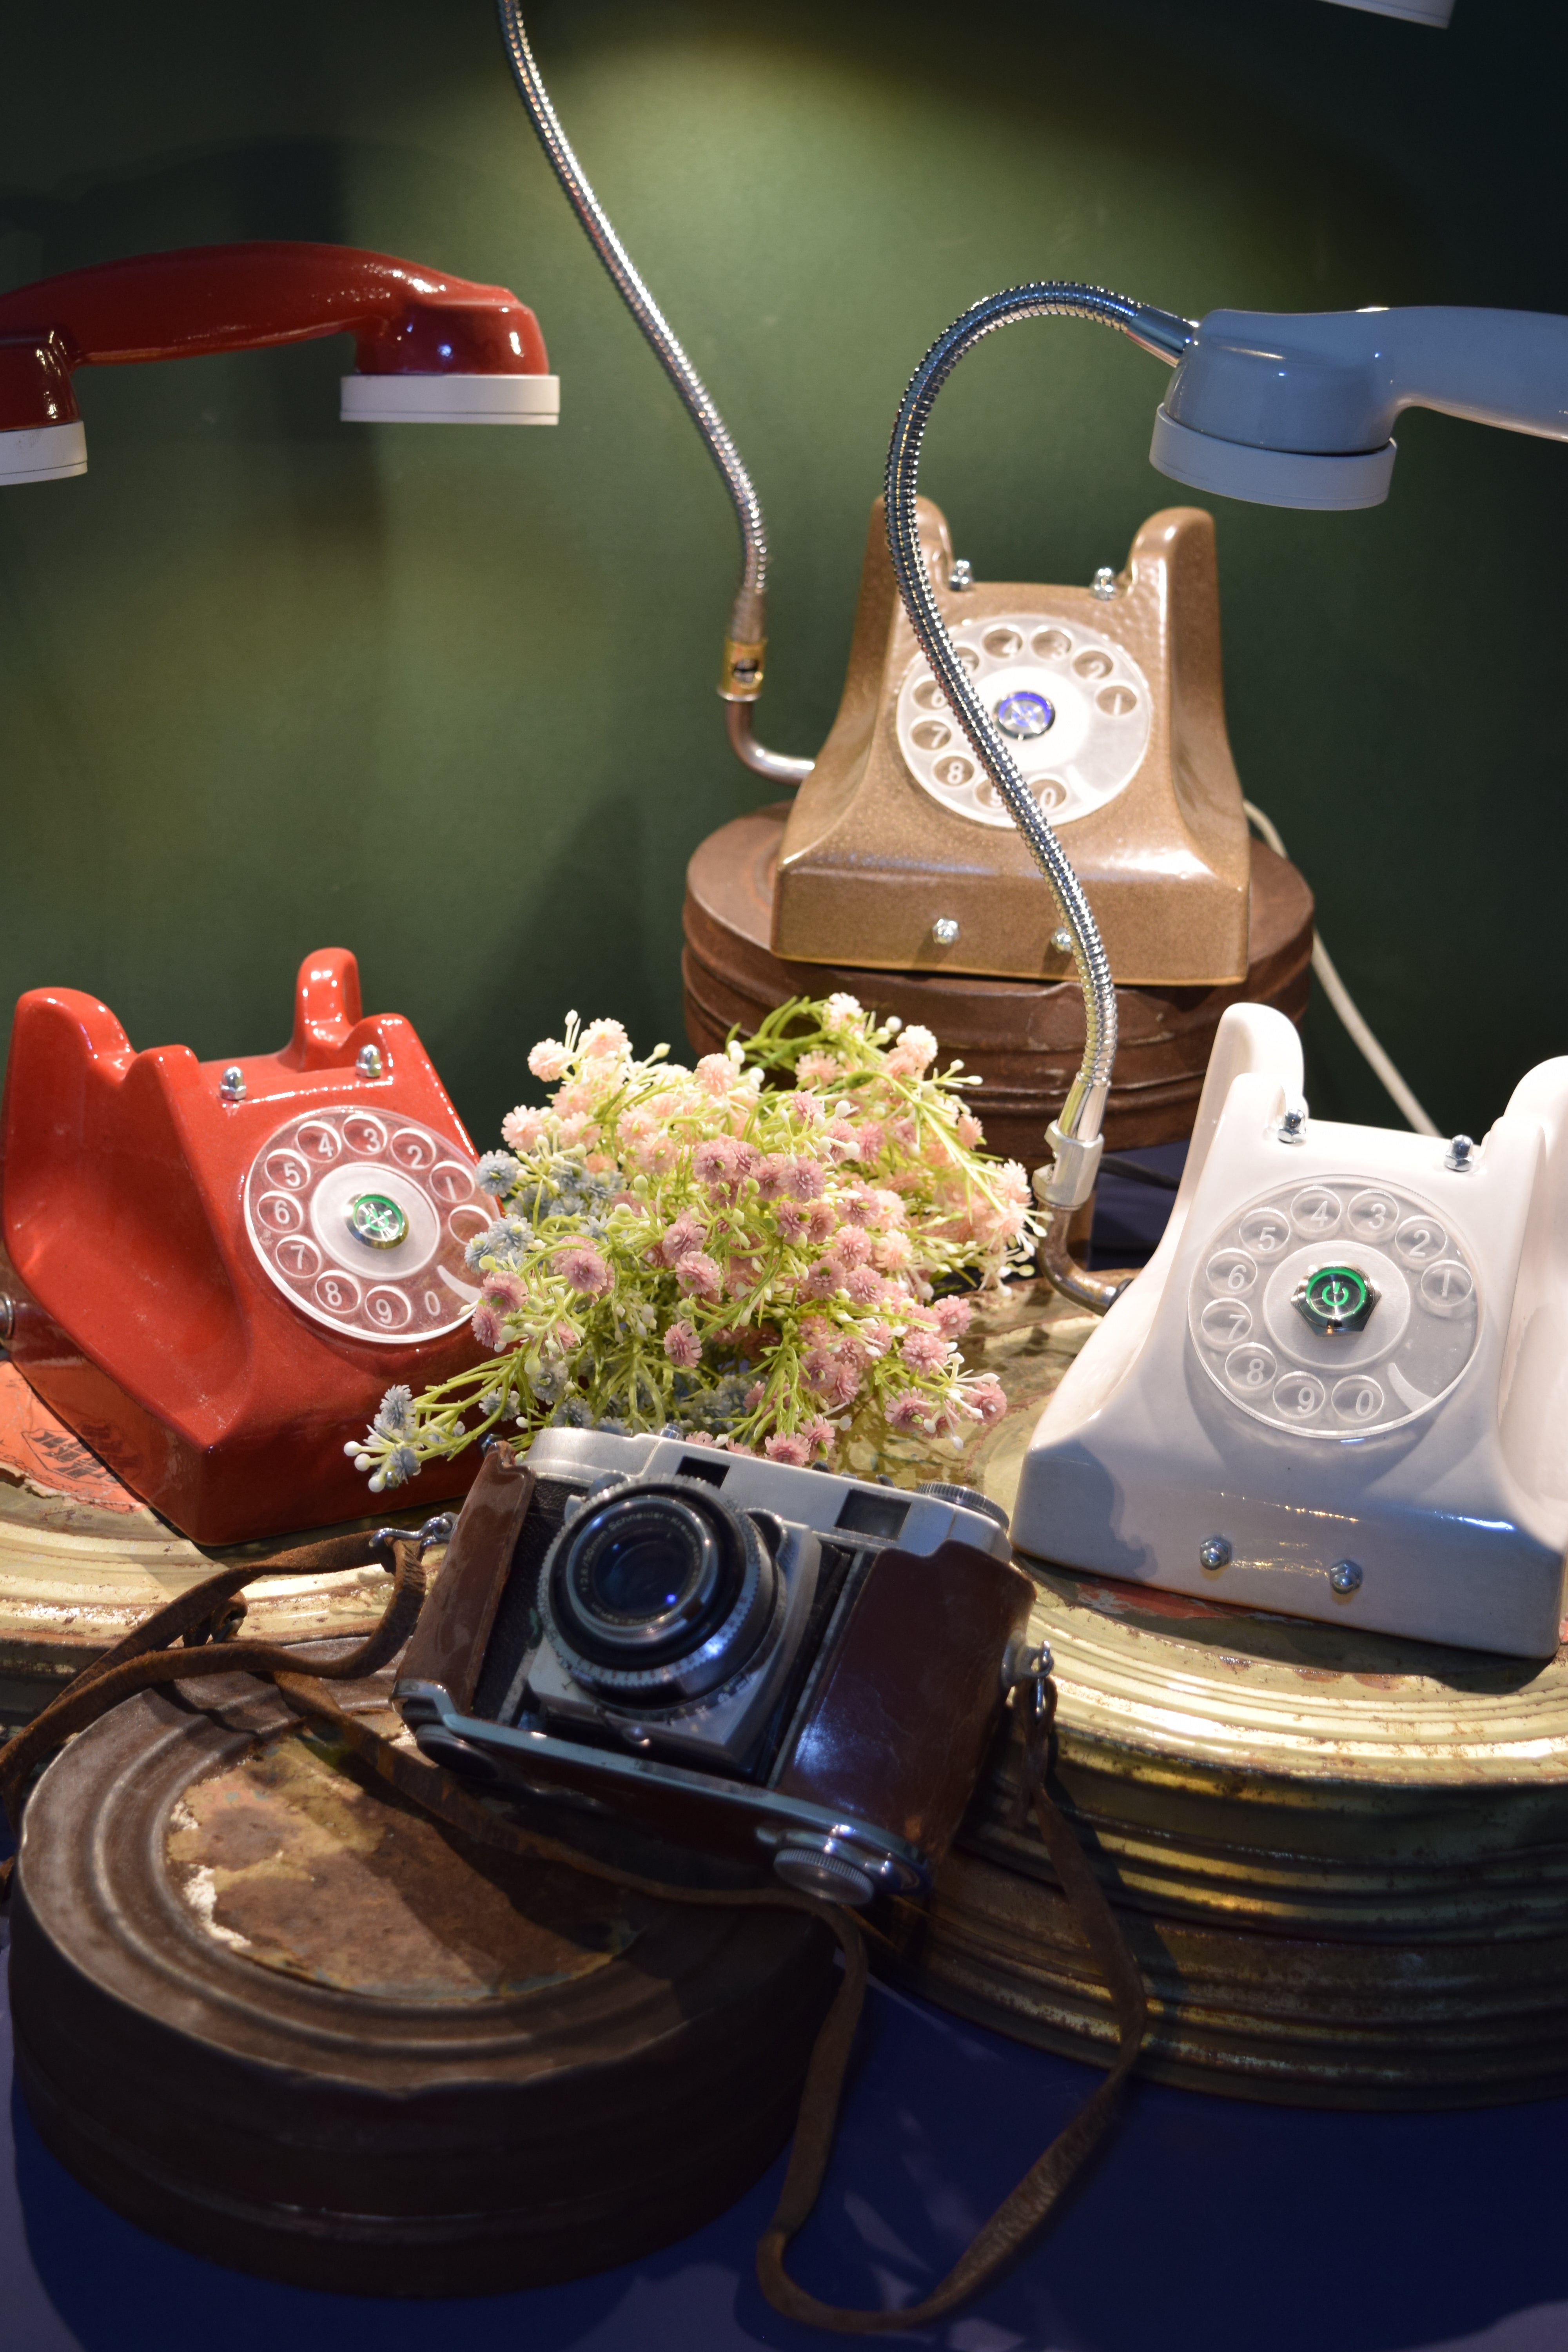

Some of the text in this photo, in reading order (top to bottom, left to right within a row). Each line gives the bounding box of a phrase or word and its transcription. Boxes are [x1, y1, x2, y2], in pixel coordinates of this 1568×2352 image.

[1002, 636, 1019, 658] 4
[1051, 640, 1067, 659] 3
[1087, 660, 1105, 681] 2
[931, 686, 947, 708] 6
[1114, 693, 1121, 716] 1
[932, 726, 948, 748] 7
[947, 762, 963, 784] 8
[1040, 787, 1056, 809] 0
[318, 1132, 333, 1157] 4
[363, 1128, 381, 1152] 3
[407, 1145, 425, 1170] 2
[283, 1162, 301, 1187] 5
[445, 1176, 457, 1201] 1
[275, 1200, 290, 1224] 6
[1311, 1201, 1328, 1227] 4
[1368, 1203, 1386, 1229] 3
[1258, 1227, 1276, 1251] 5
[1408, 1229, 1430, 1258] 2
[290, 1245, 305, 1270] 7
[1228, 1265, 1247, 1290] 6
[1442, 1269, 1450, 1297] 1
[325, 1281, 342, 1307] 8
[425, 1291, 441, 1316] 0
[376, 1298, 392, 1324] 9
[1228, 1314, 1246, 1340] 7
[1247, 1358, 1264, 1385] 8
[1297, 1387, 1315, 1414] 9
[1356, 1390, 1374, 1417] 0
